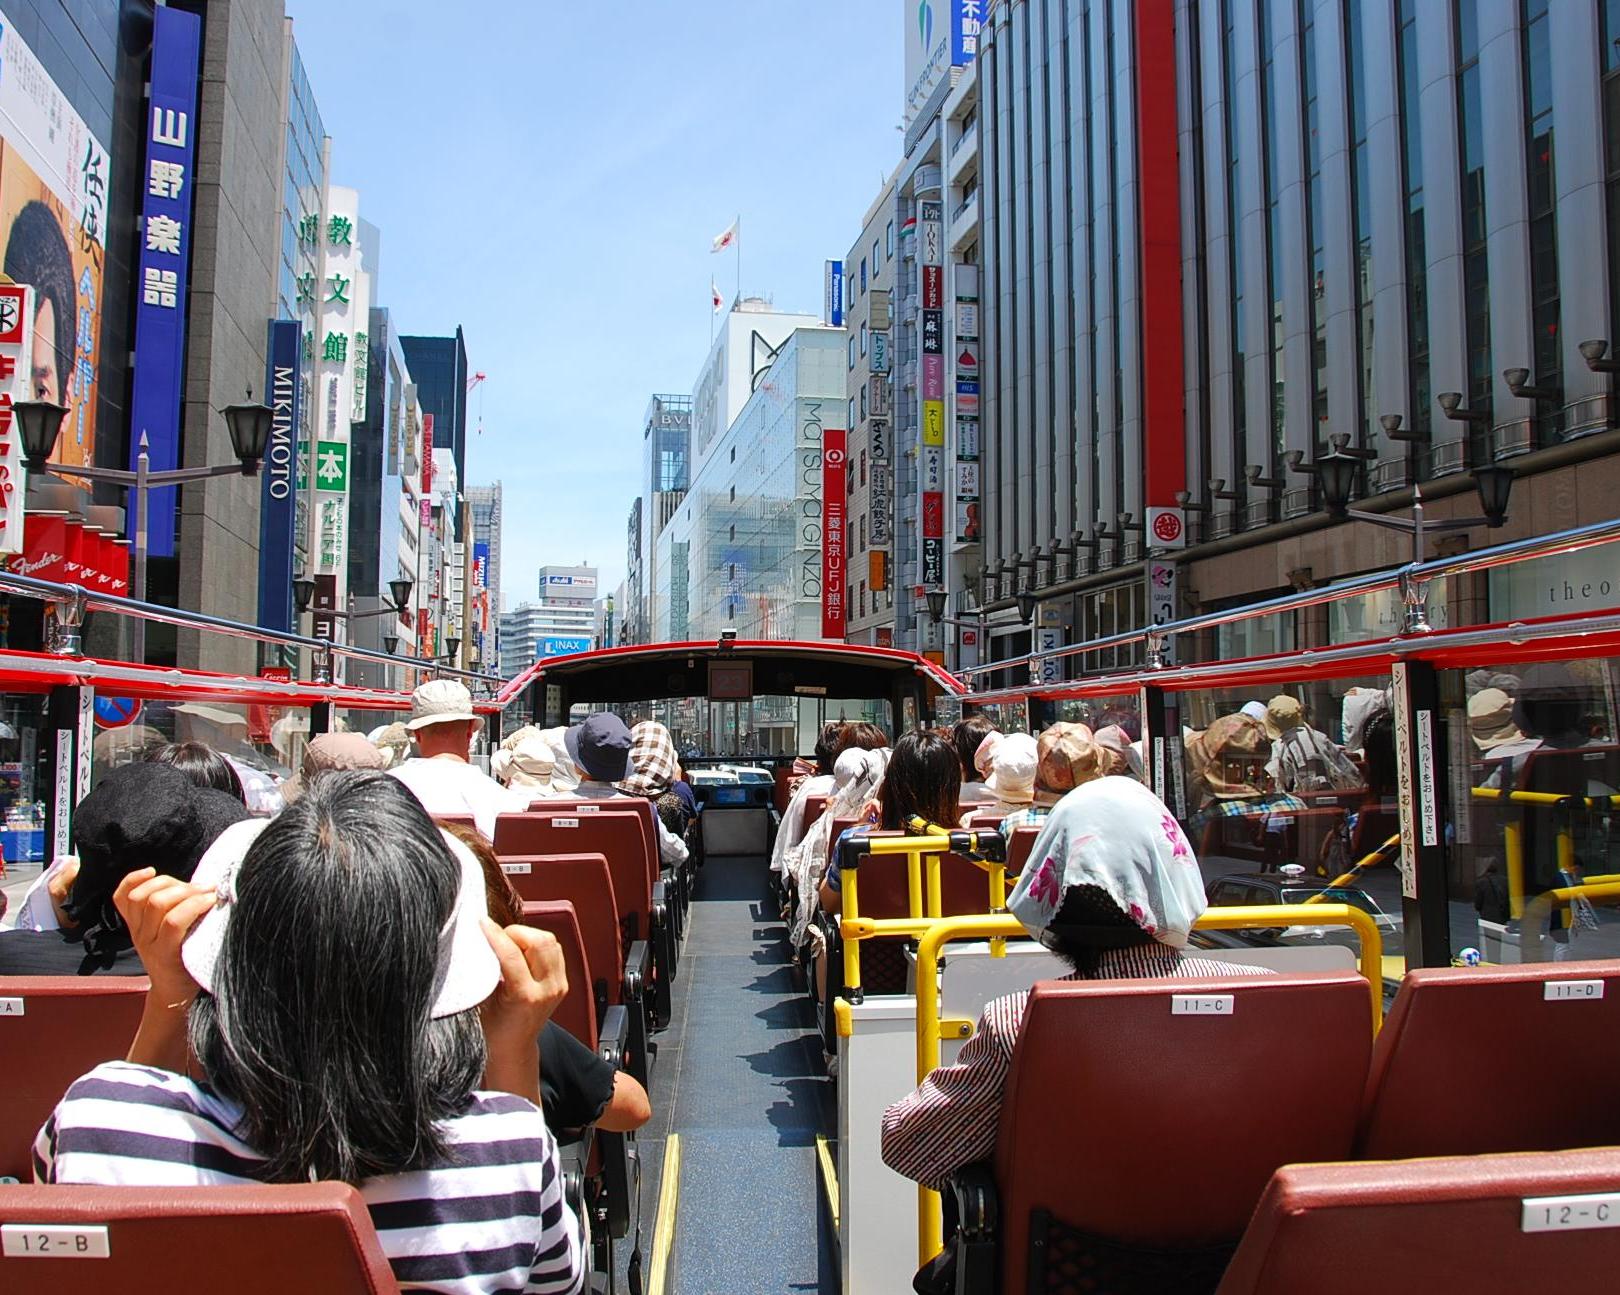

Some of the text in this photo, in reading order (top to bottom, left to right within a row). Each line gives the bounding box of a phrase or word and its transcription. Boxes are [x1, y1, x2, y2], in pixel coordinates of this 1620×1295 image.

[143, 105, 189, 310] 山野楽器
[322, 214, 353, 364] 教文館
[833, 273, 841, 313] Panasonic
[269, 366, 294, 501] MIKIMOTO
[872, 421, 886, 458] ざくろ
[318, 449, 344, 484] 本
[323, 500, 336, 565] ナルニア国
[11, 551, 63, 576] Fender
[826, 502, 841, 620] 三菱東京UFJ銀行
[924, 540, 937, 583] コーヒー屋
[1379, 604, 1447, 625] thry
[555, 640, 580, 650] INAX
[1394, 670, 1416, 893] シートベルトをおしめ下さい
[1420, 711, 1436, 844] シートベルトをおしめ下さい
[1183, 999, 1224, 1012] 11-C
[1556, 984, 1595, 997] 11-D
[1544, 1203, 1610, 1225] 12-C
[22, 1234, 89, 1252] 12-B
